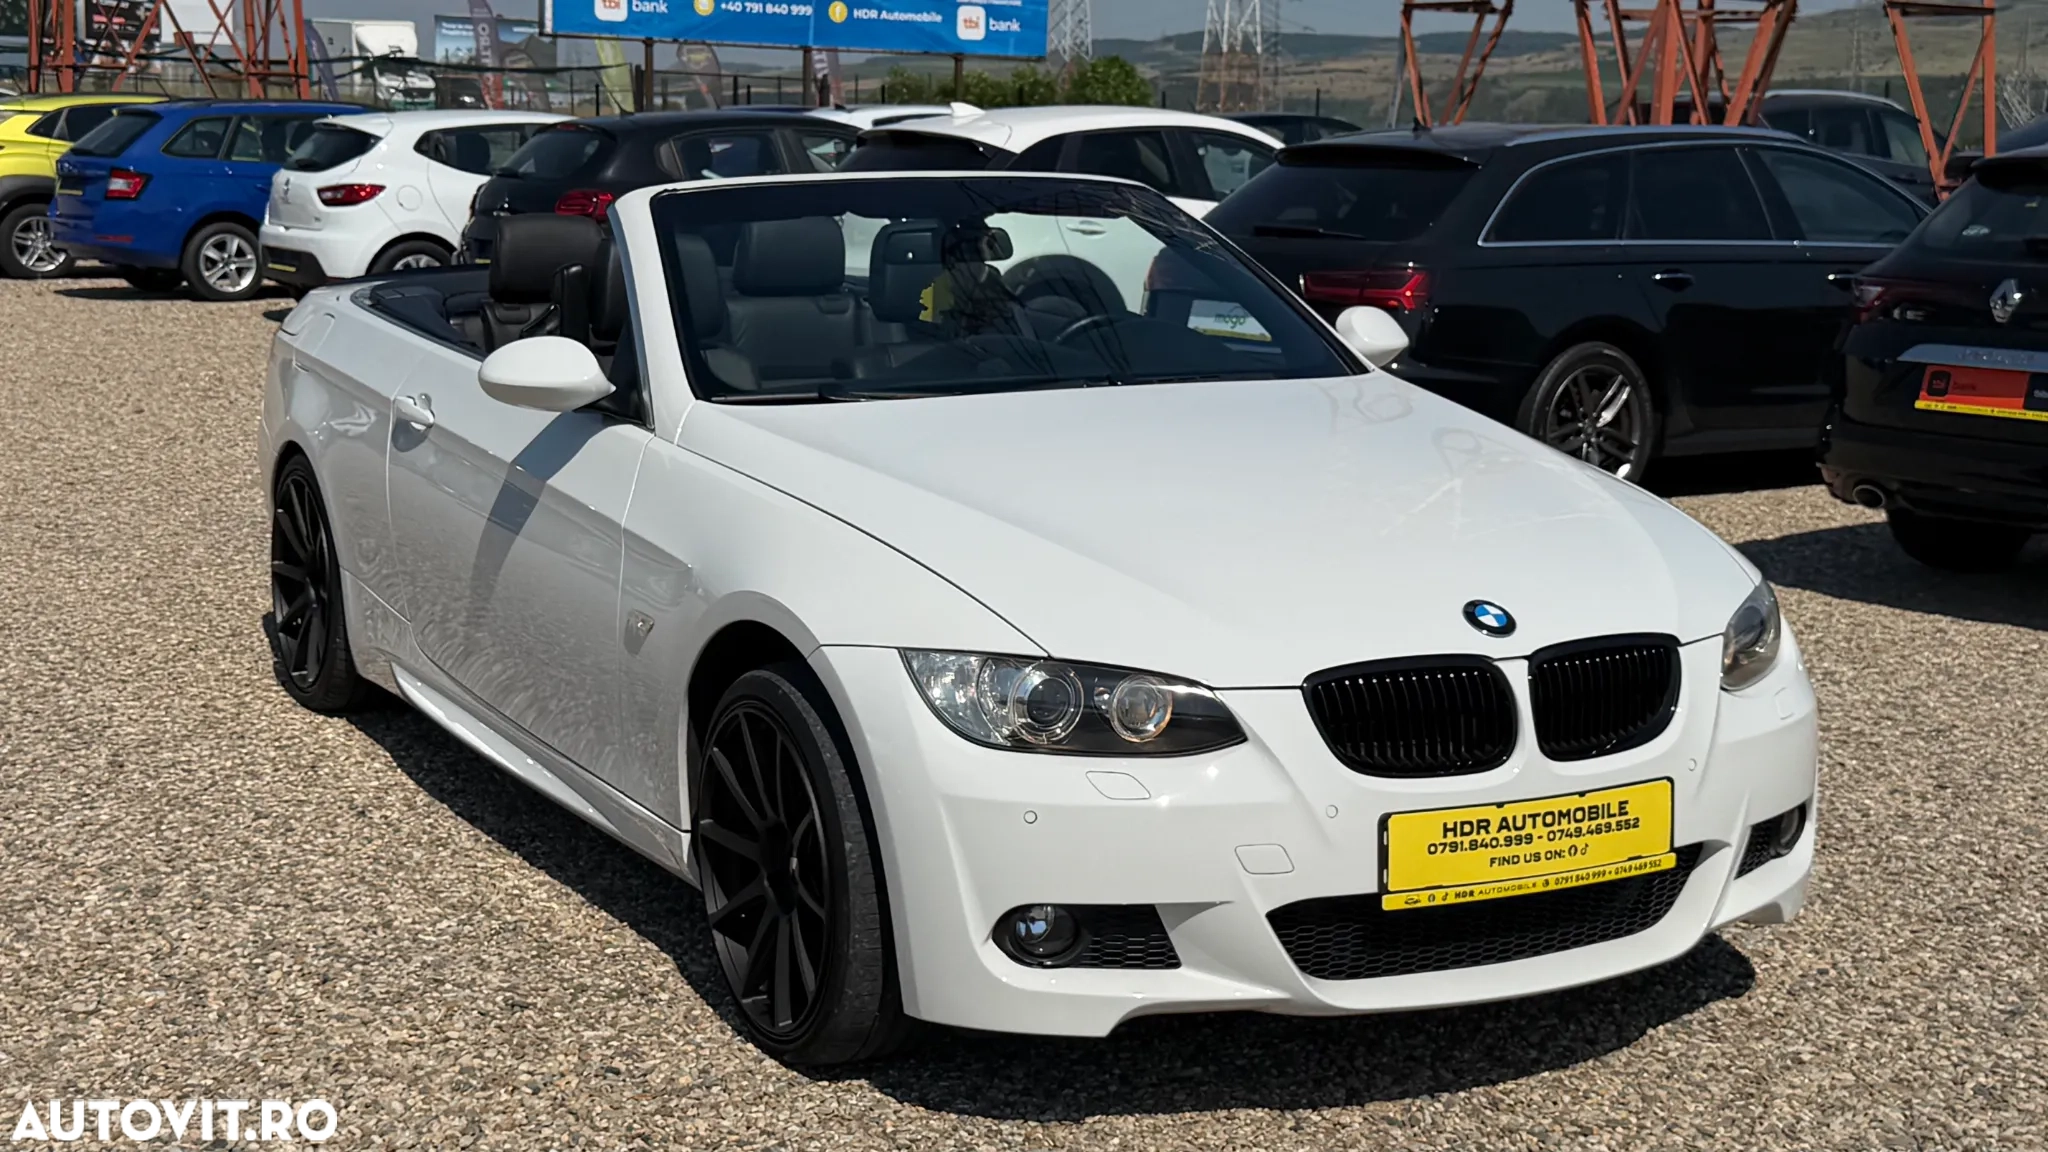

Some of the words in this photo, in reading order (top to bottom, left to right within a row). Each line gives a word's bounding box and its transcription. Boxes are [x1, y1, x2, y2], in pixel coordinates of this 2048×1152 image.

[632, 0, 668, 13] bank
[744, 2, 763, 13] 791
[766, 3, 788, 15] 840
[790, 4, 813, 16] 999
[853, 8, 879, 19] HDR
[880, 10, 942, 23] Automobile
[964, 16, 980, 29] tbi
[989, 17, 1021, 32] bank
[1442, 818, 1491, 838] HDR
[1496, 800, 1629, 833] AUTOMOBILE
[1427, 833, 1533, 855] 0791.840.999
[1547, 817, 1640, 842] 0749.469.552
[1489, 854, 1521, 868] FIND
[1523, 852, 1541, 863] US
[1544, 849, 1566, 861] ON:
[1454, 890, 1475, 899] HDR
[1478, 882, 1537, 895] AUTOMOBILE
[1554, 875, 1574, 886] 0791
[1575, 873, 1590, 883] 840
[1591, 869, 1607, 880] 999
